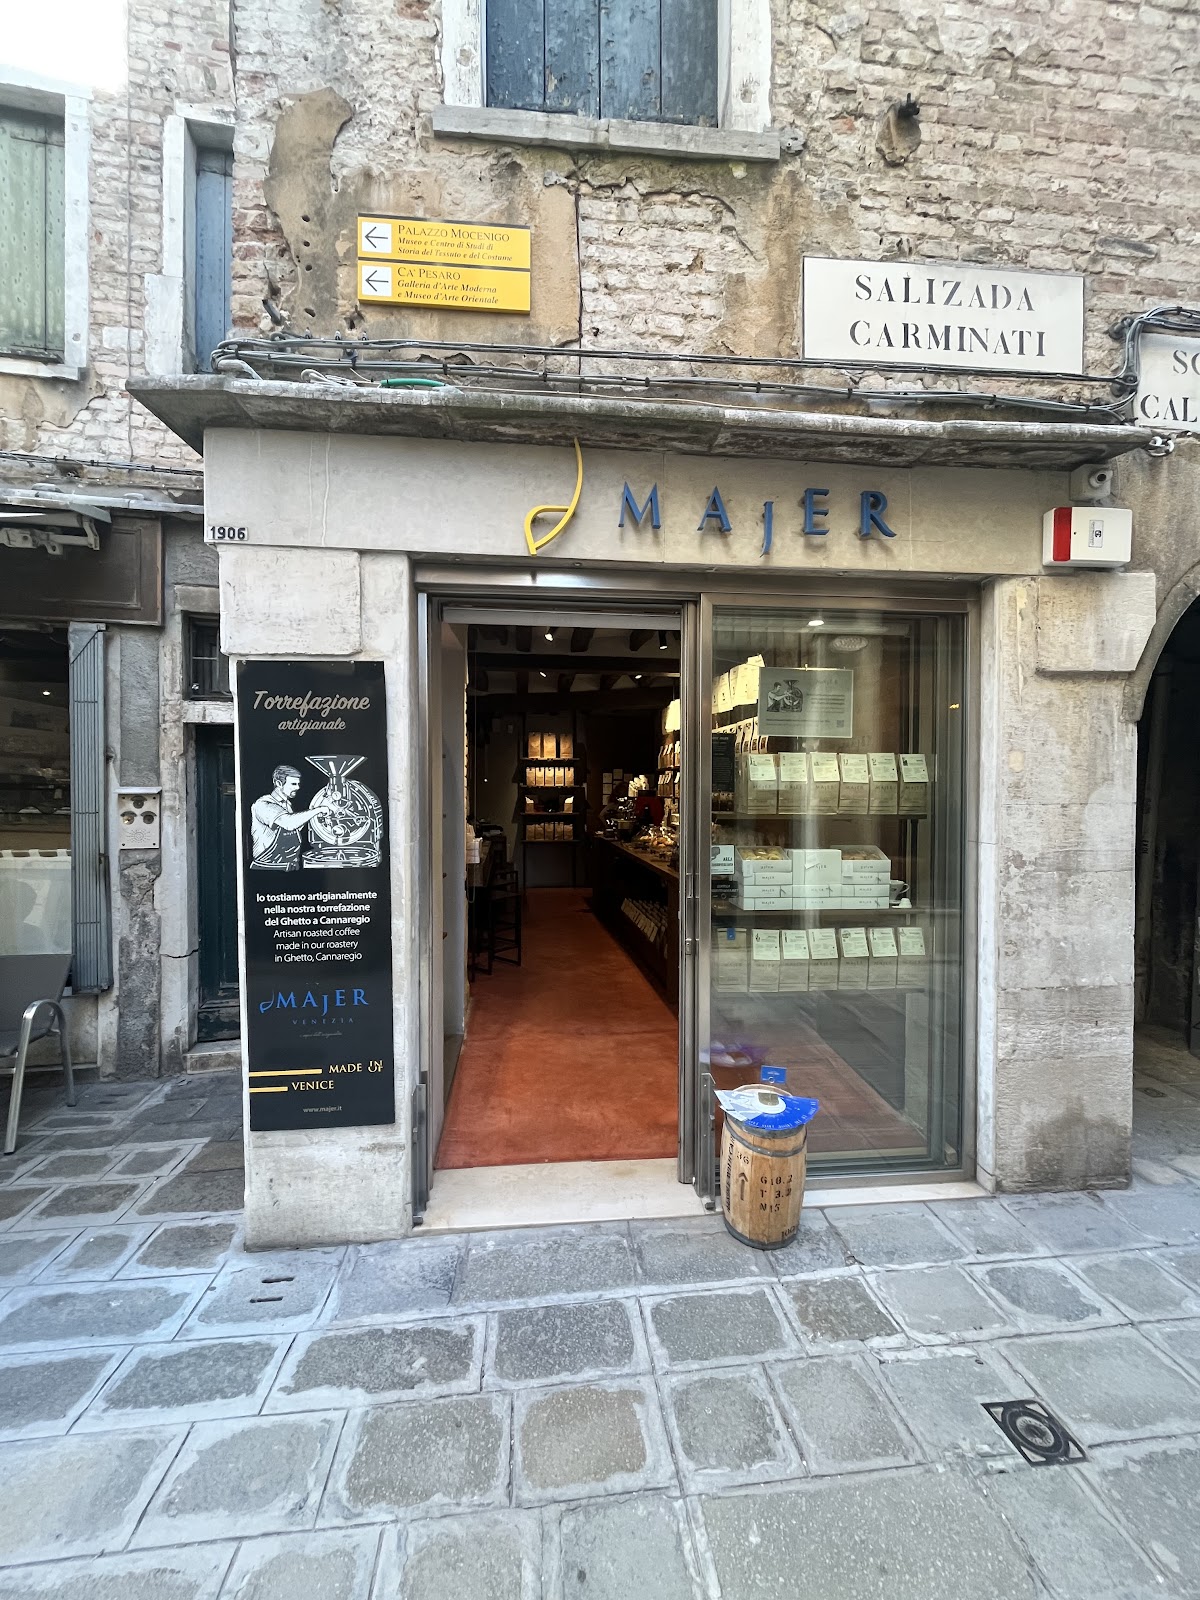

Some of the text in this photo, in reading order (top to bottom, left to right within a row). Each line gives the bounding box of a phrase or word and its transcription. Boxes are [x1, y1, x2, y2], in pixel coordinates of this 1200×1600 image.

[398, 224, 510, 242] PALAZZO MOCENIGO
[398, 237, 422, 246] Museo
[430, 240, 454, 248] Centro
[466, 242, 484, 250] Studi
[434, 250, 462, 258] Tessuto
[482, 253, 512, 262] Costume
[418, 268, 461, 280] PESARO
[398, 280, 430, 289] Galleria
[460, 284, 497, 294] Moderna
[855, 274, 1035, 312] SALIZADA
[404, 291, 432, 300] Museo
[461, 294, 499, 304] Orientale
[849, 320, 1046, 357] CARMINATI
[618, 481, 897, 558] MAJER
[210, 526, 246, 540] 1906
[254, 690, 370, 718] Torrefazione
[278, 718, 346, 736] artigianale
[266, 892, 306, 902] tostiamo
[307, 891, 378, 902] artigianalmente
[264, 905, 286, 914] nella
[316, 903, 370, 912] torrefazione
[264, 918, 280, 926] del
[280, 917, 312, 926] Ghetto
[320, 915, 370, 926] Cannaregio
[274, 927, 360, 938] Artisan roasted coffee
[276, 941, 300, 950] made
[302, 941, 310, 950] in
[326, 940, 359, 950] roastery
[274, 952, 362, 962] in Ghetto, Cannaregio
[276, 988, 369, 1016] MAJER
[329, 1063, 362, 1074] MADE
[292, 1080, 334, 1090] VENICE
